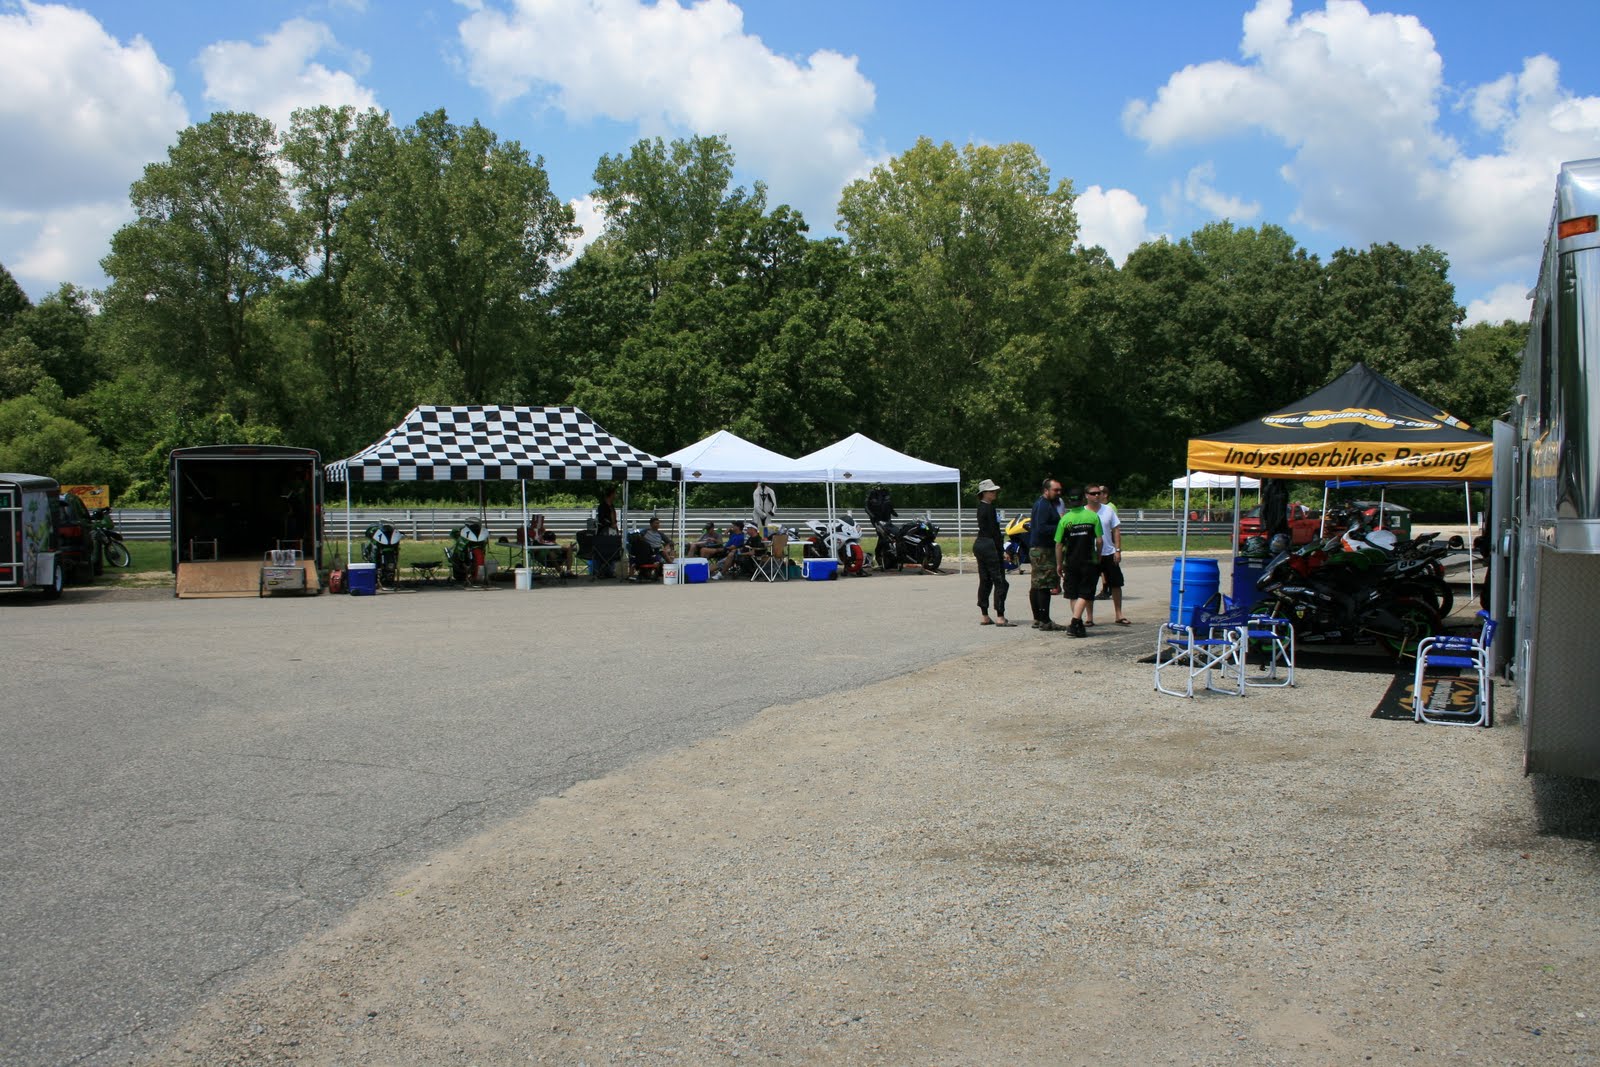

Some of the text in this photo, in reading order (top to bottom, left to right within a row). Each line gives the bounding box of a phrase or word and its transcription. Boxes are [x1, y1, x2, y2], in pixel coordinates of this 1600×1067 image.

[1224, 447, 1471, 472] Indysuperbikes Racing
[378, 533, 383, 542] 1
